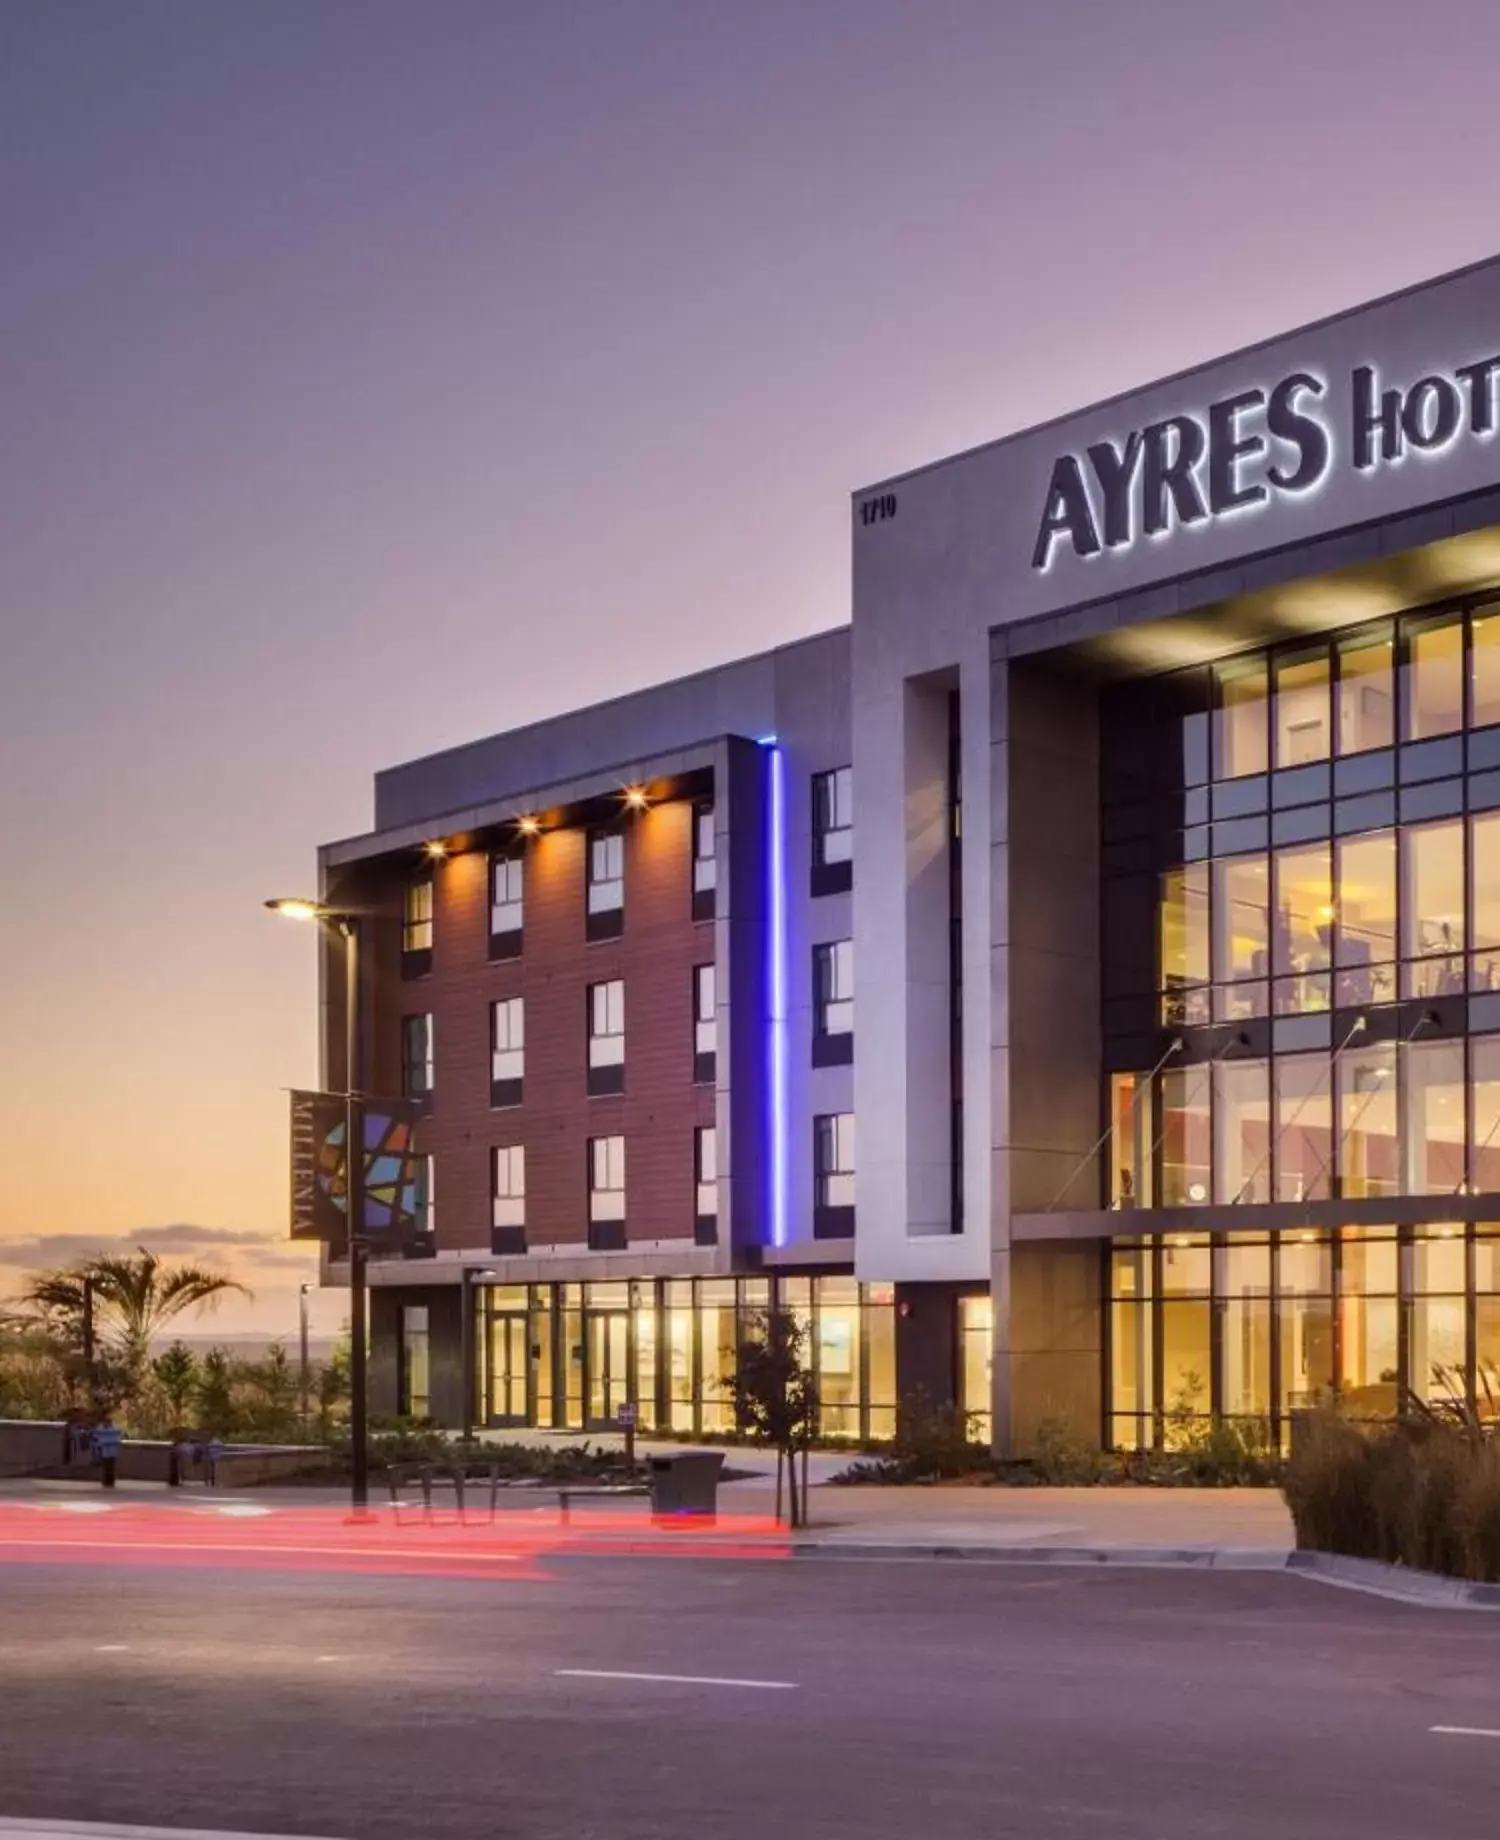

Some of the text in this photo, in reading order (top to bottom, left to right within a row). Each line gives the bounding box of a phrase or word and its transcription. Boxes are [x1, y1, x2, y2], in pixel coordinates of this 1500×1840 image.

[860, 494, 896, 526] 1710
[1032, 373, 1329, 570] AYRES
[293, 1101, 314, 1230] MILLENIA
